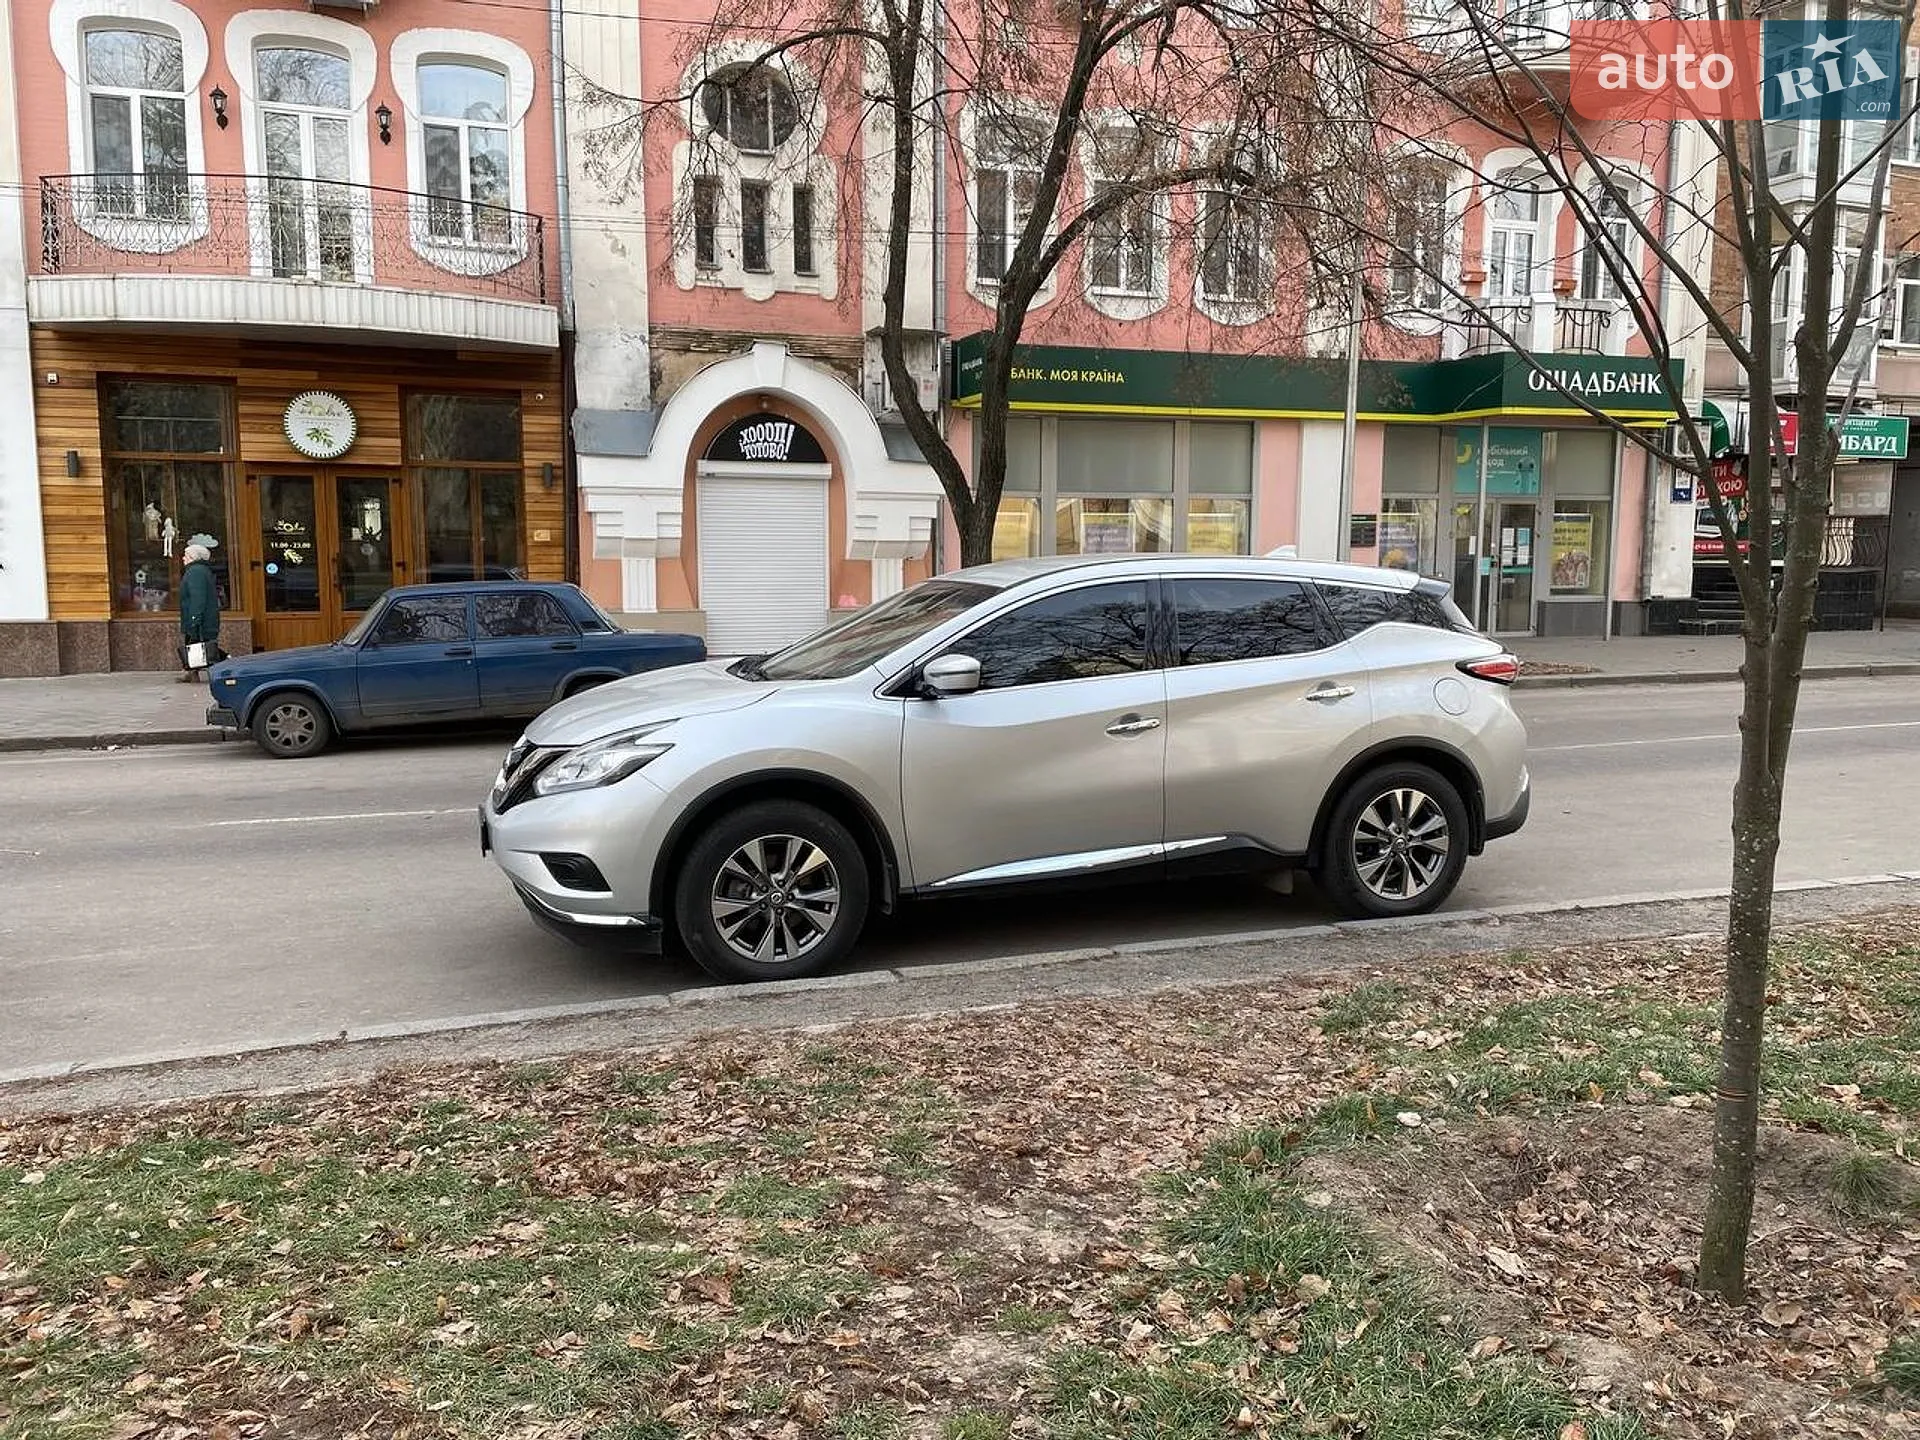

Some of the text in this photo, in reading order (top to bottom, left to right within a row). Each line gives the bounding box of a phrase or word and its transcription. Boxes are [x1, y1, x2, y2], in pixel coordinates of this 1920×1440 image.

[1010, 367, 1125, 384] БАНК. МОЯ КРАЇНА
